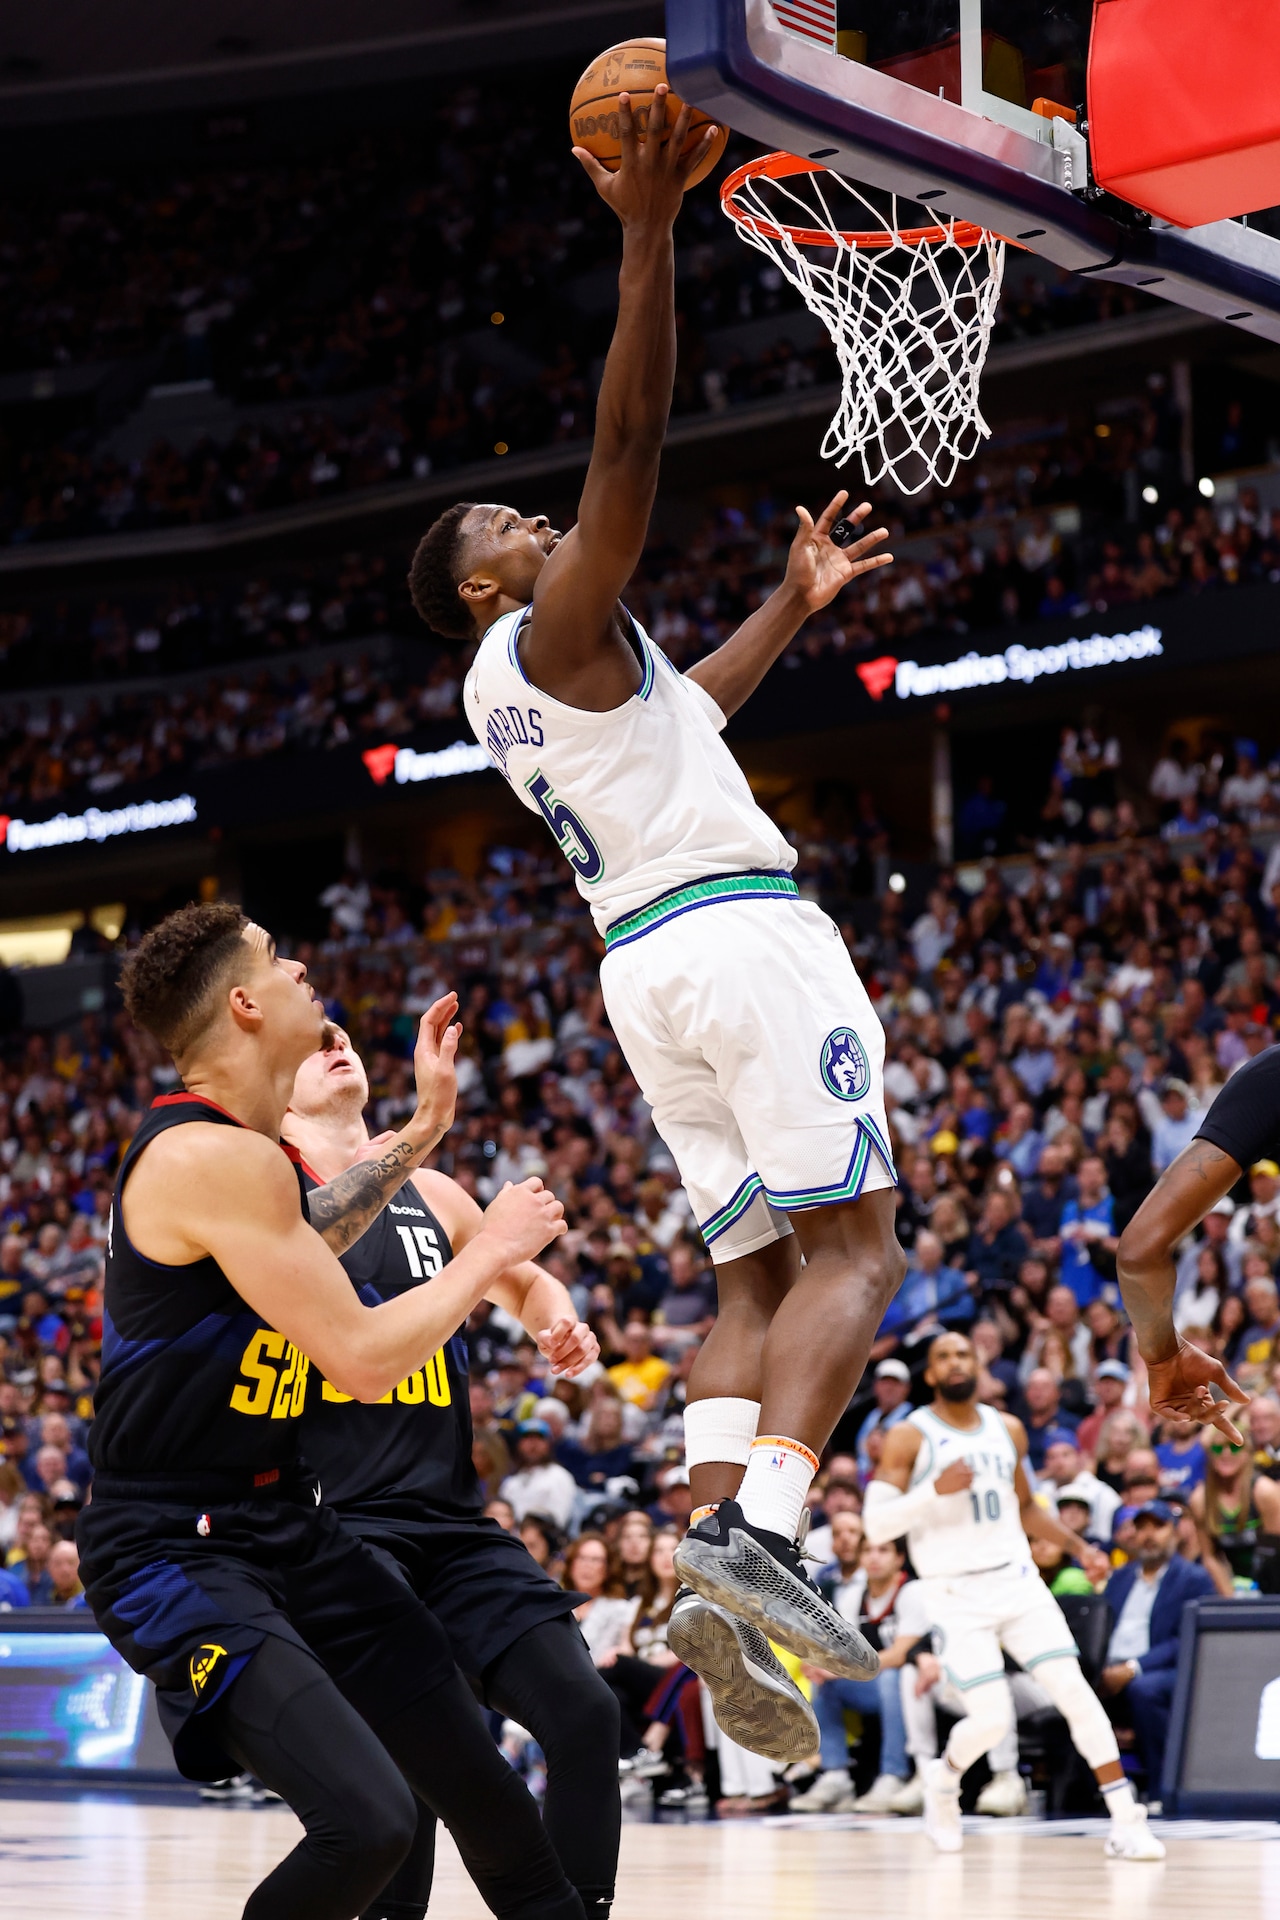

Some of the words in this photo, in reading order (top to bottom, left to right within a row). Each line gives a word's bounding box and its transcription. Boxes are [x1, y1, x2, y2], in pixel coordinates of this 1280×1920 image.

[835, 525, 850, 540] 21
[523, 767, 606, 885] 5
[388, 1203, 426, 1218] ibotta
[396, 1225, 444, 1279] 15
[969, 1489, 1001, 1524] 10
